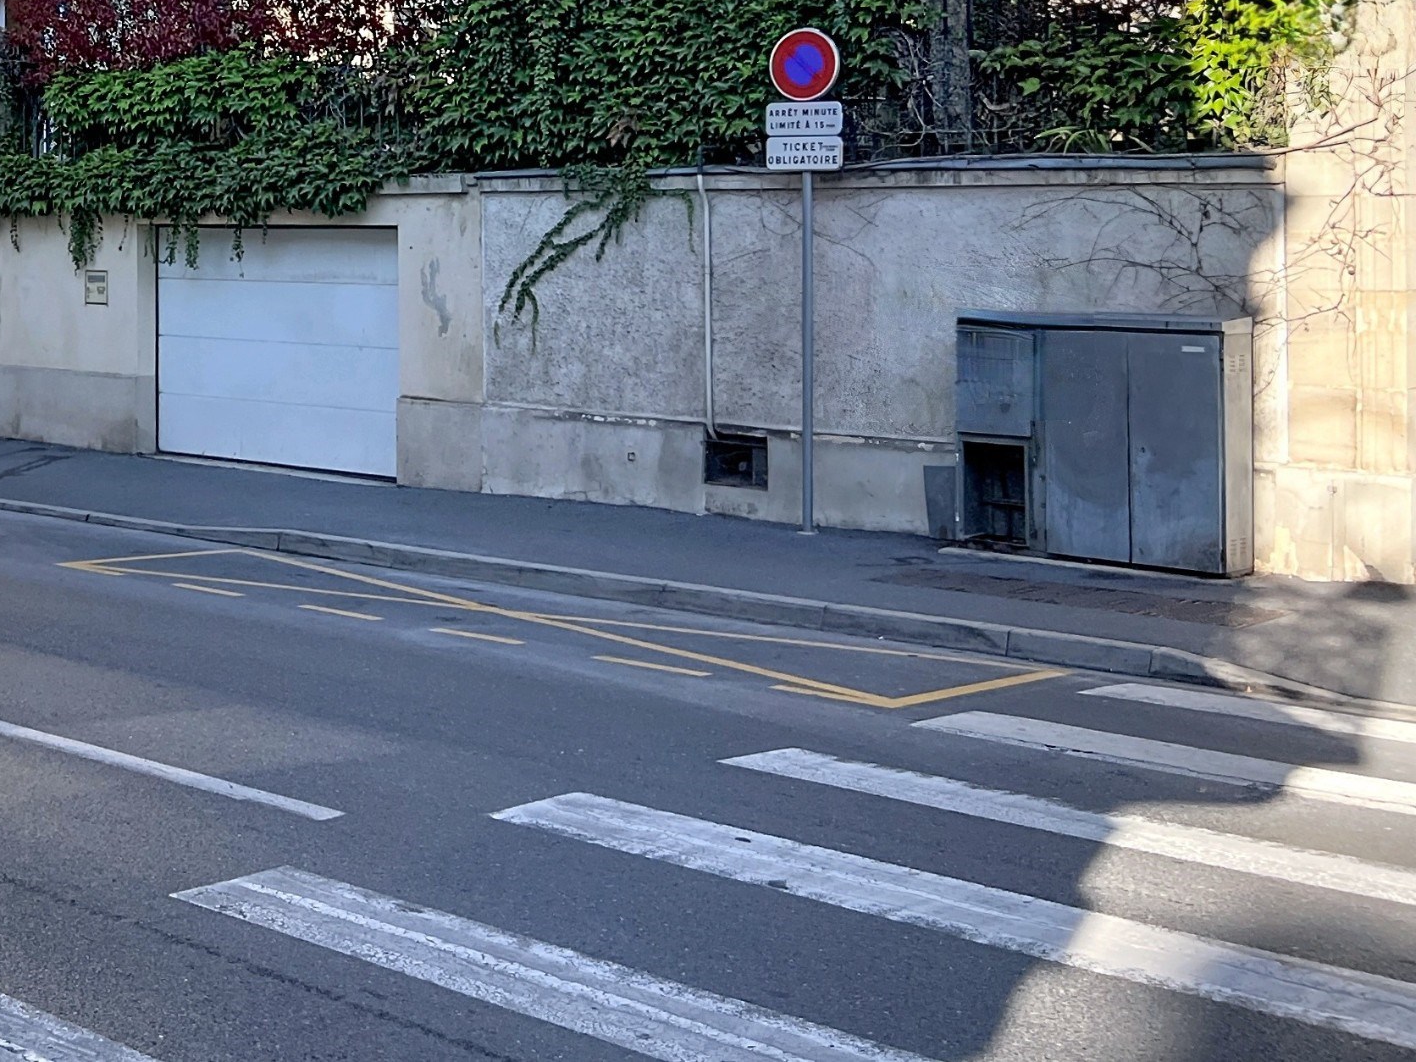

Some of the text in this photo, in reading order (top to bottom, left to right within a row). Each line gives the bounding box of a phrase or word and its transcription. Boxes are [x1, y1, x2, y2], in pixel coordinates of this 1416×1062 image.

[769, 108, 838, 117] ARRÊT MINUTE
[770, 120, 800, 129] LIMITÉ
[805, 120, 810, 129] À
[815, 121, 824, 129] 15
[782, 142, 823, 151] TICKET
[768, 155, 838, 164] OBLIGATOIRE
